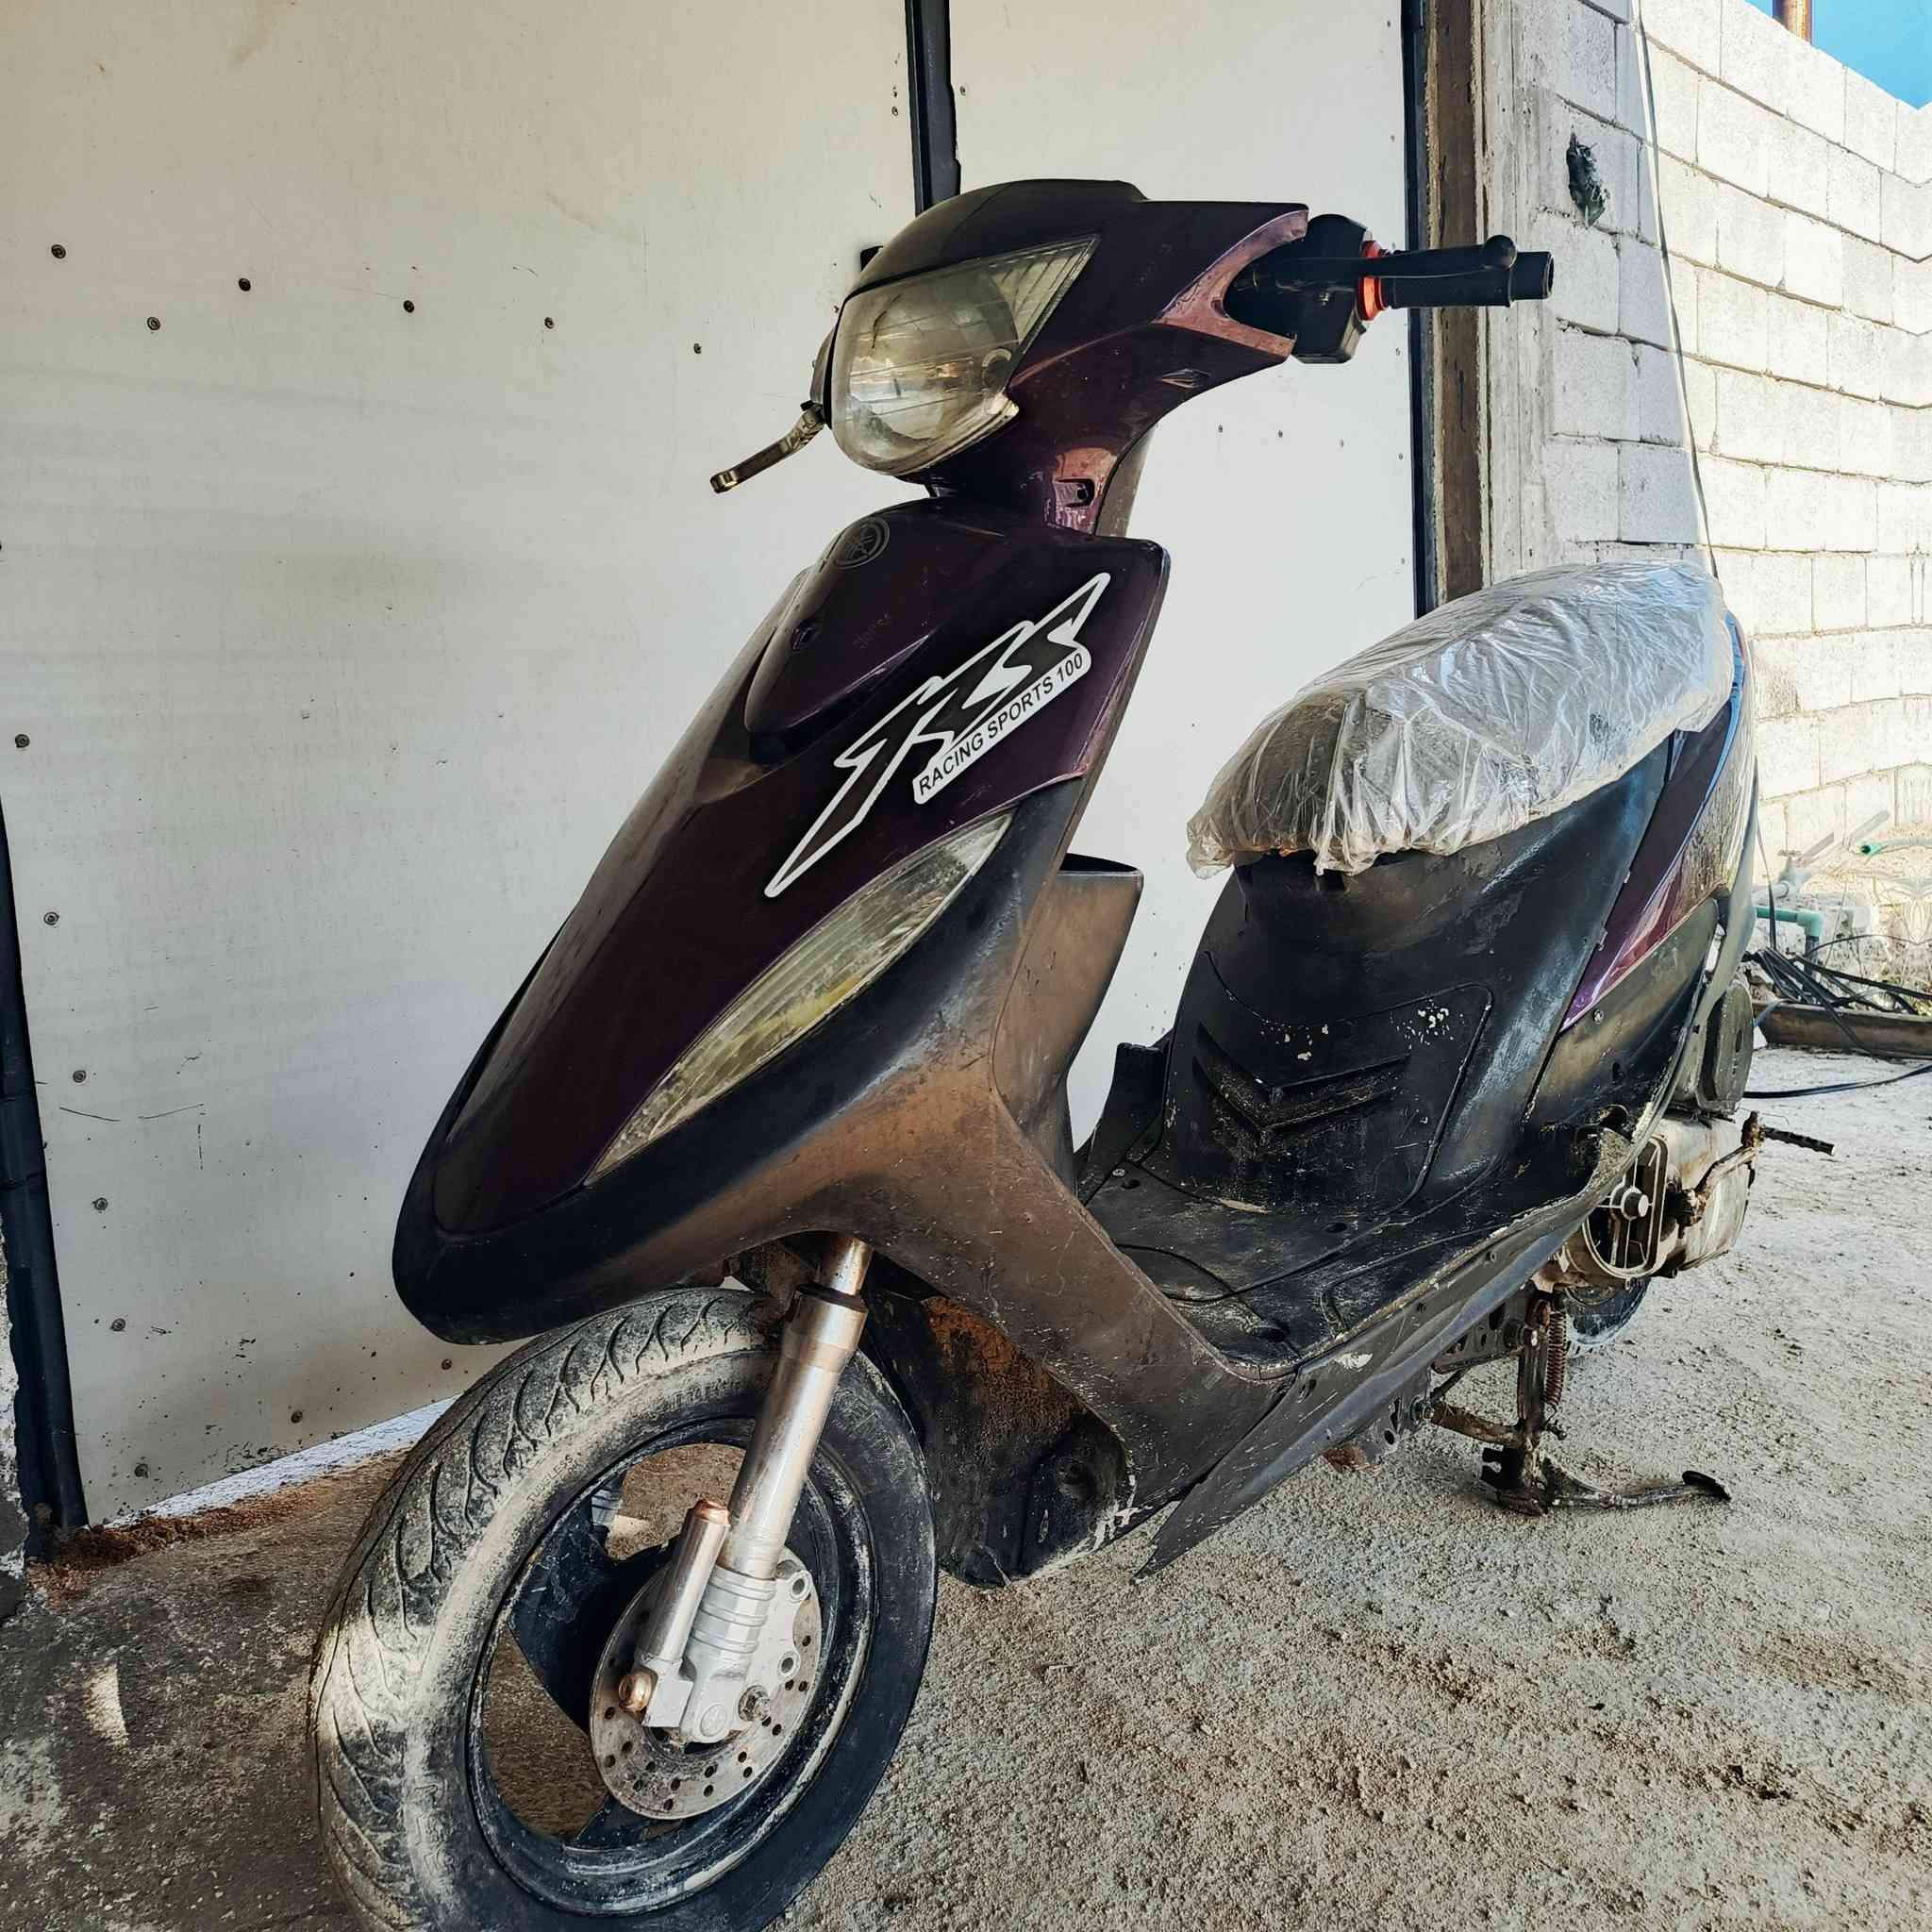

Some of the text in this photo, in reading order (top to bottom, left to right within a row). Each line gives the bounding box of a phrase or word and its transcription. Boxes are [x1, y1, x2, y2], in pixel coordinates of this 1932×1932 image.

[918, 652, 1084, 796] RACING SPORTS 100
